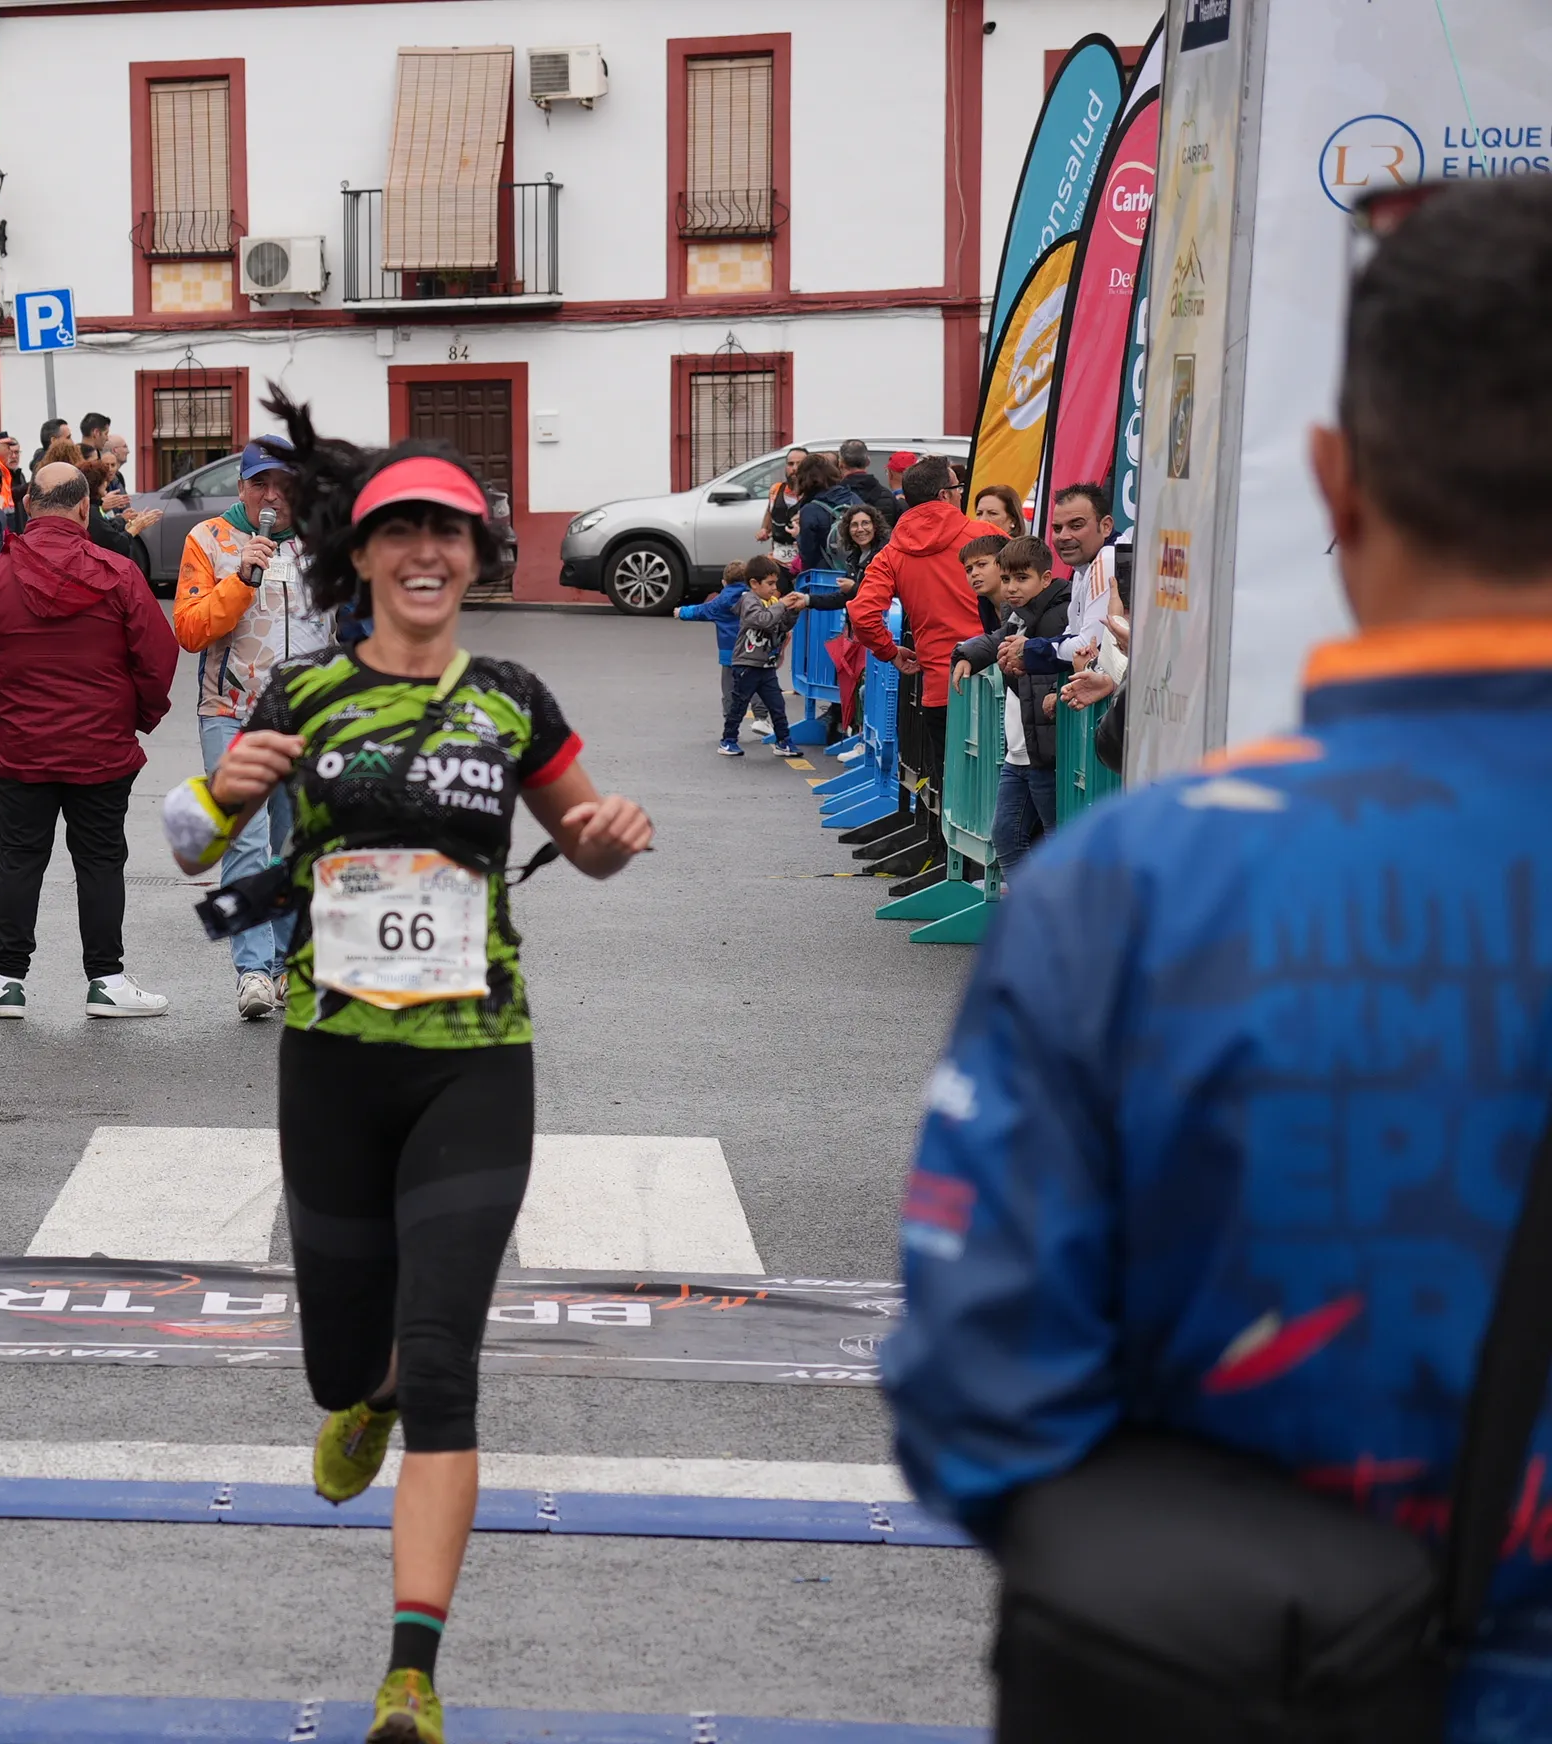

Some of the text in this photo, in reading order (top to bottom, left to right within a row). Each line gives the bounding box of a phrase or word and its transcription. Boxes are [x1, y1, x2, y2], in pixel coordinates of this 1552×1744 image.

[1444, 126, 1542, 149] LUQUE
[1442, 157, 1459, 179] E
[1135, 217, 1147, 230] 18
[25, 294, 65, 348] P
[449, 345, 469, 360] 84
[379, 911, 436, 951] 66
